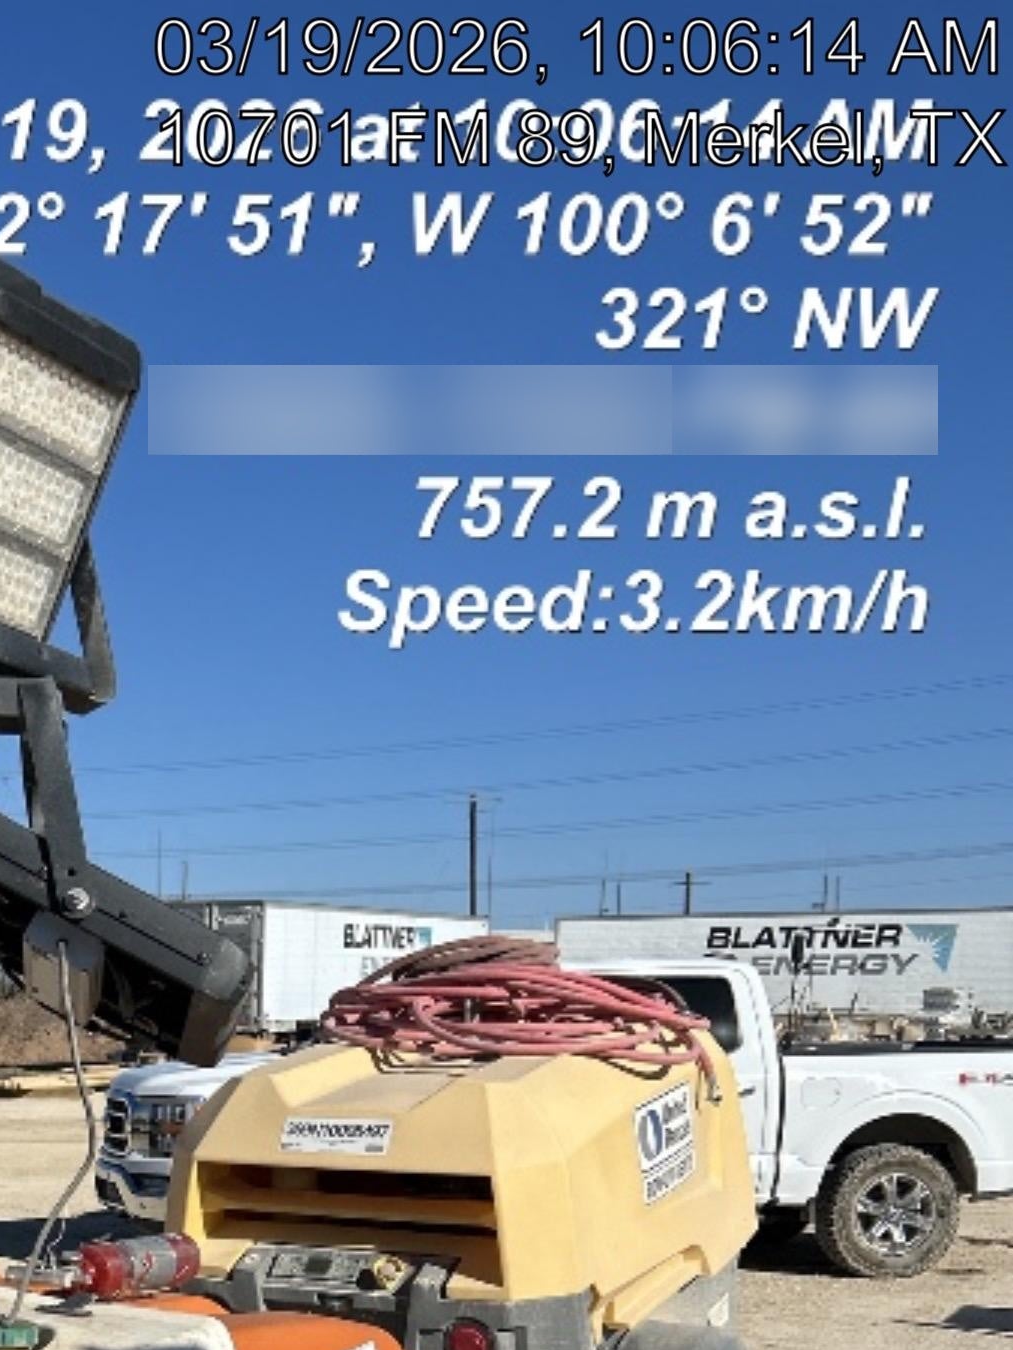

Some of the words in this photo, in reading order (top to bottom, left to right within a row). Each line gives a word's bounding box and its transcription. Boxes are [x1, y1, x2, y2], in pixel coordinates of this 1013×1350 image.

[343, 923, 414, 949] BLATTNER
[706, 923, 903, 949] BLATTNER
[751, 953, 919, 976] ENERGY
